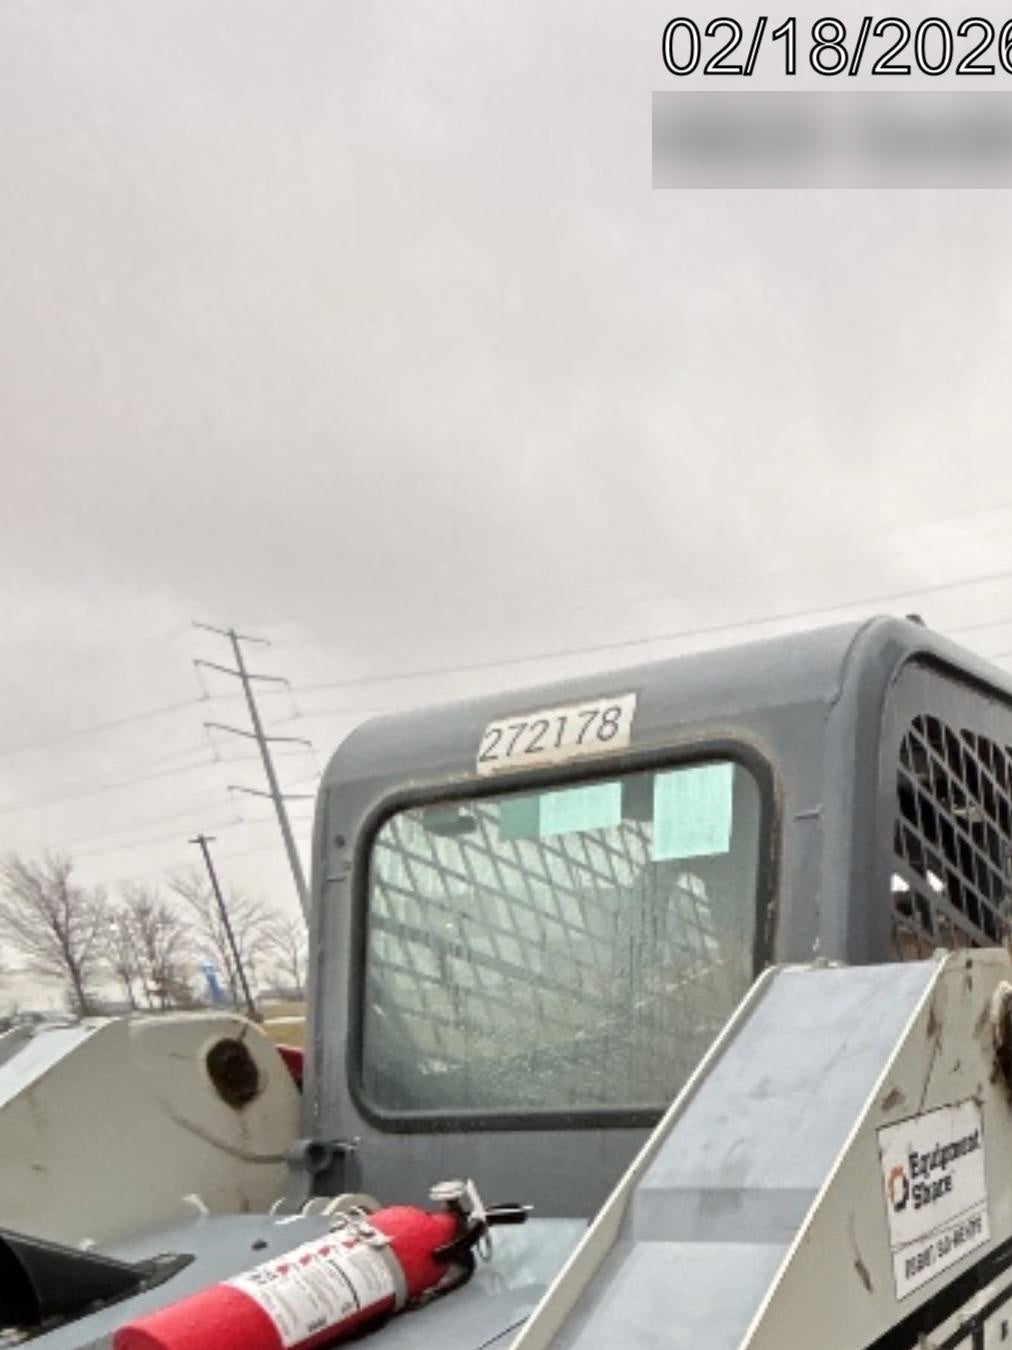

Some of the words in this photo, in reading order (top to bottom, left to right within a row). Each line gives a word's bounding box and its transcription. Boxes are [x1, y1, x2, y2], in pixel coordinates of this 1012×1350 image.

[478, 705, 622, 763] 272178
[908, 1129, 980, 1180] Equipment
[911, 1175, 953, 1210] Share
